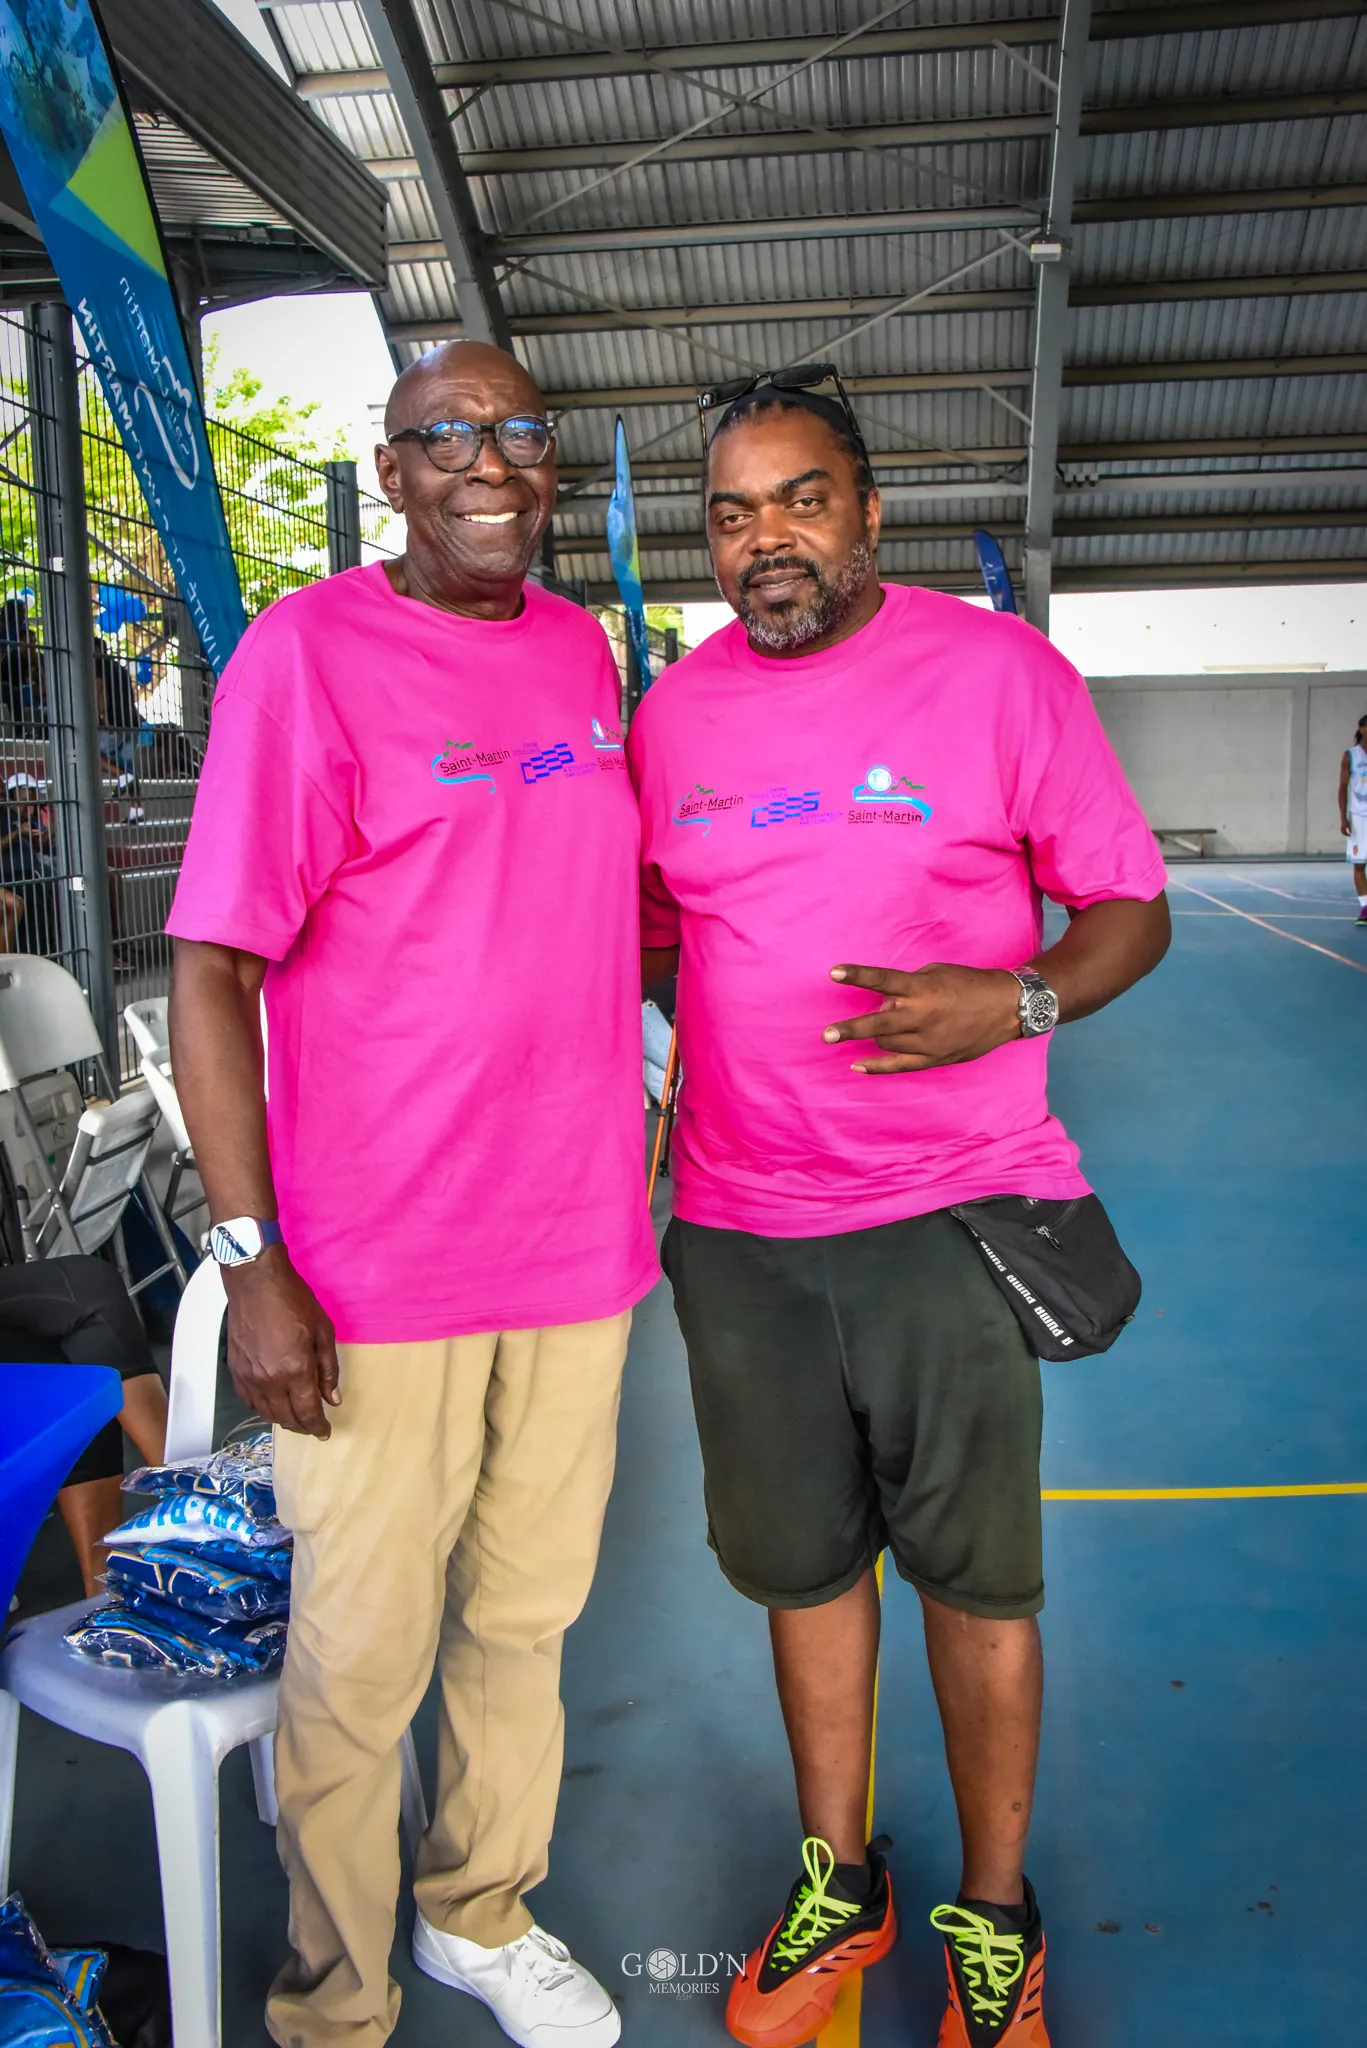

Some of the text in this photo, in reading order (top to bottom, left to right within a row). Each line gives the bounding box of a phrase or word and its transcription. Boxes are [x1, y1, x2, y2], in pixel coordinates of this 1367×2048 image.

[440, 749, 511, 773] Saint-Martin
[680, 795, 743, 815] Saint-Martin
[848, 809, 922, 823] Saint-Martin
[1006, 1273, 1037, 1304] PUMA
[1034, 1305, 1064, 1338] PUMA
